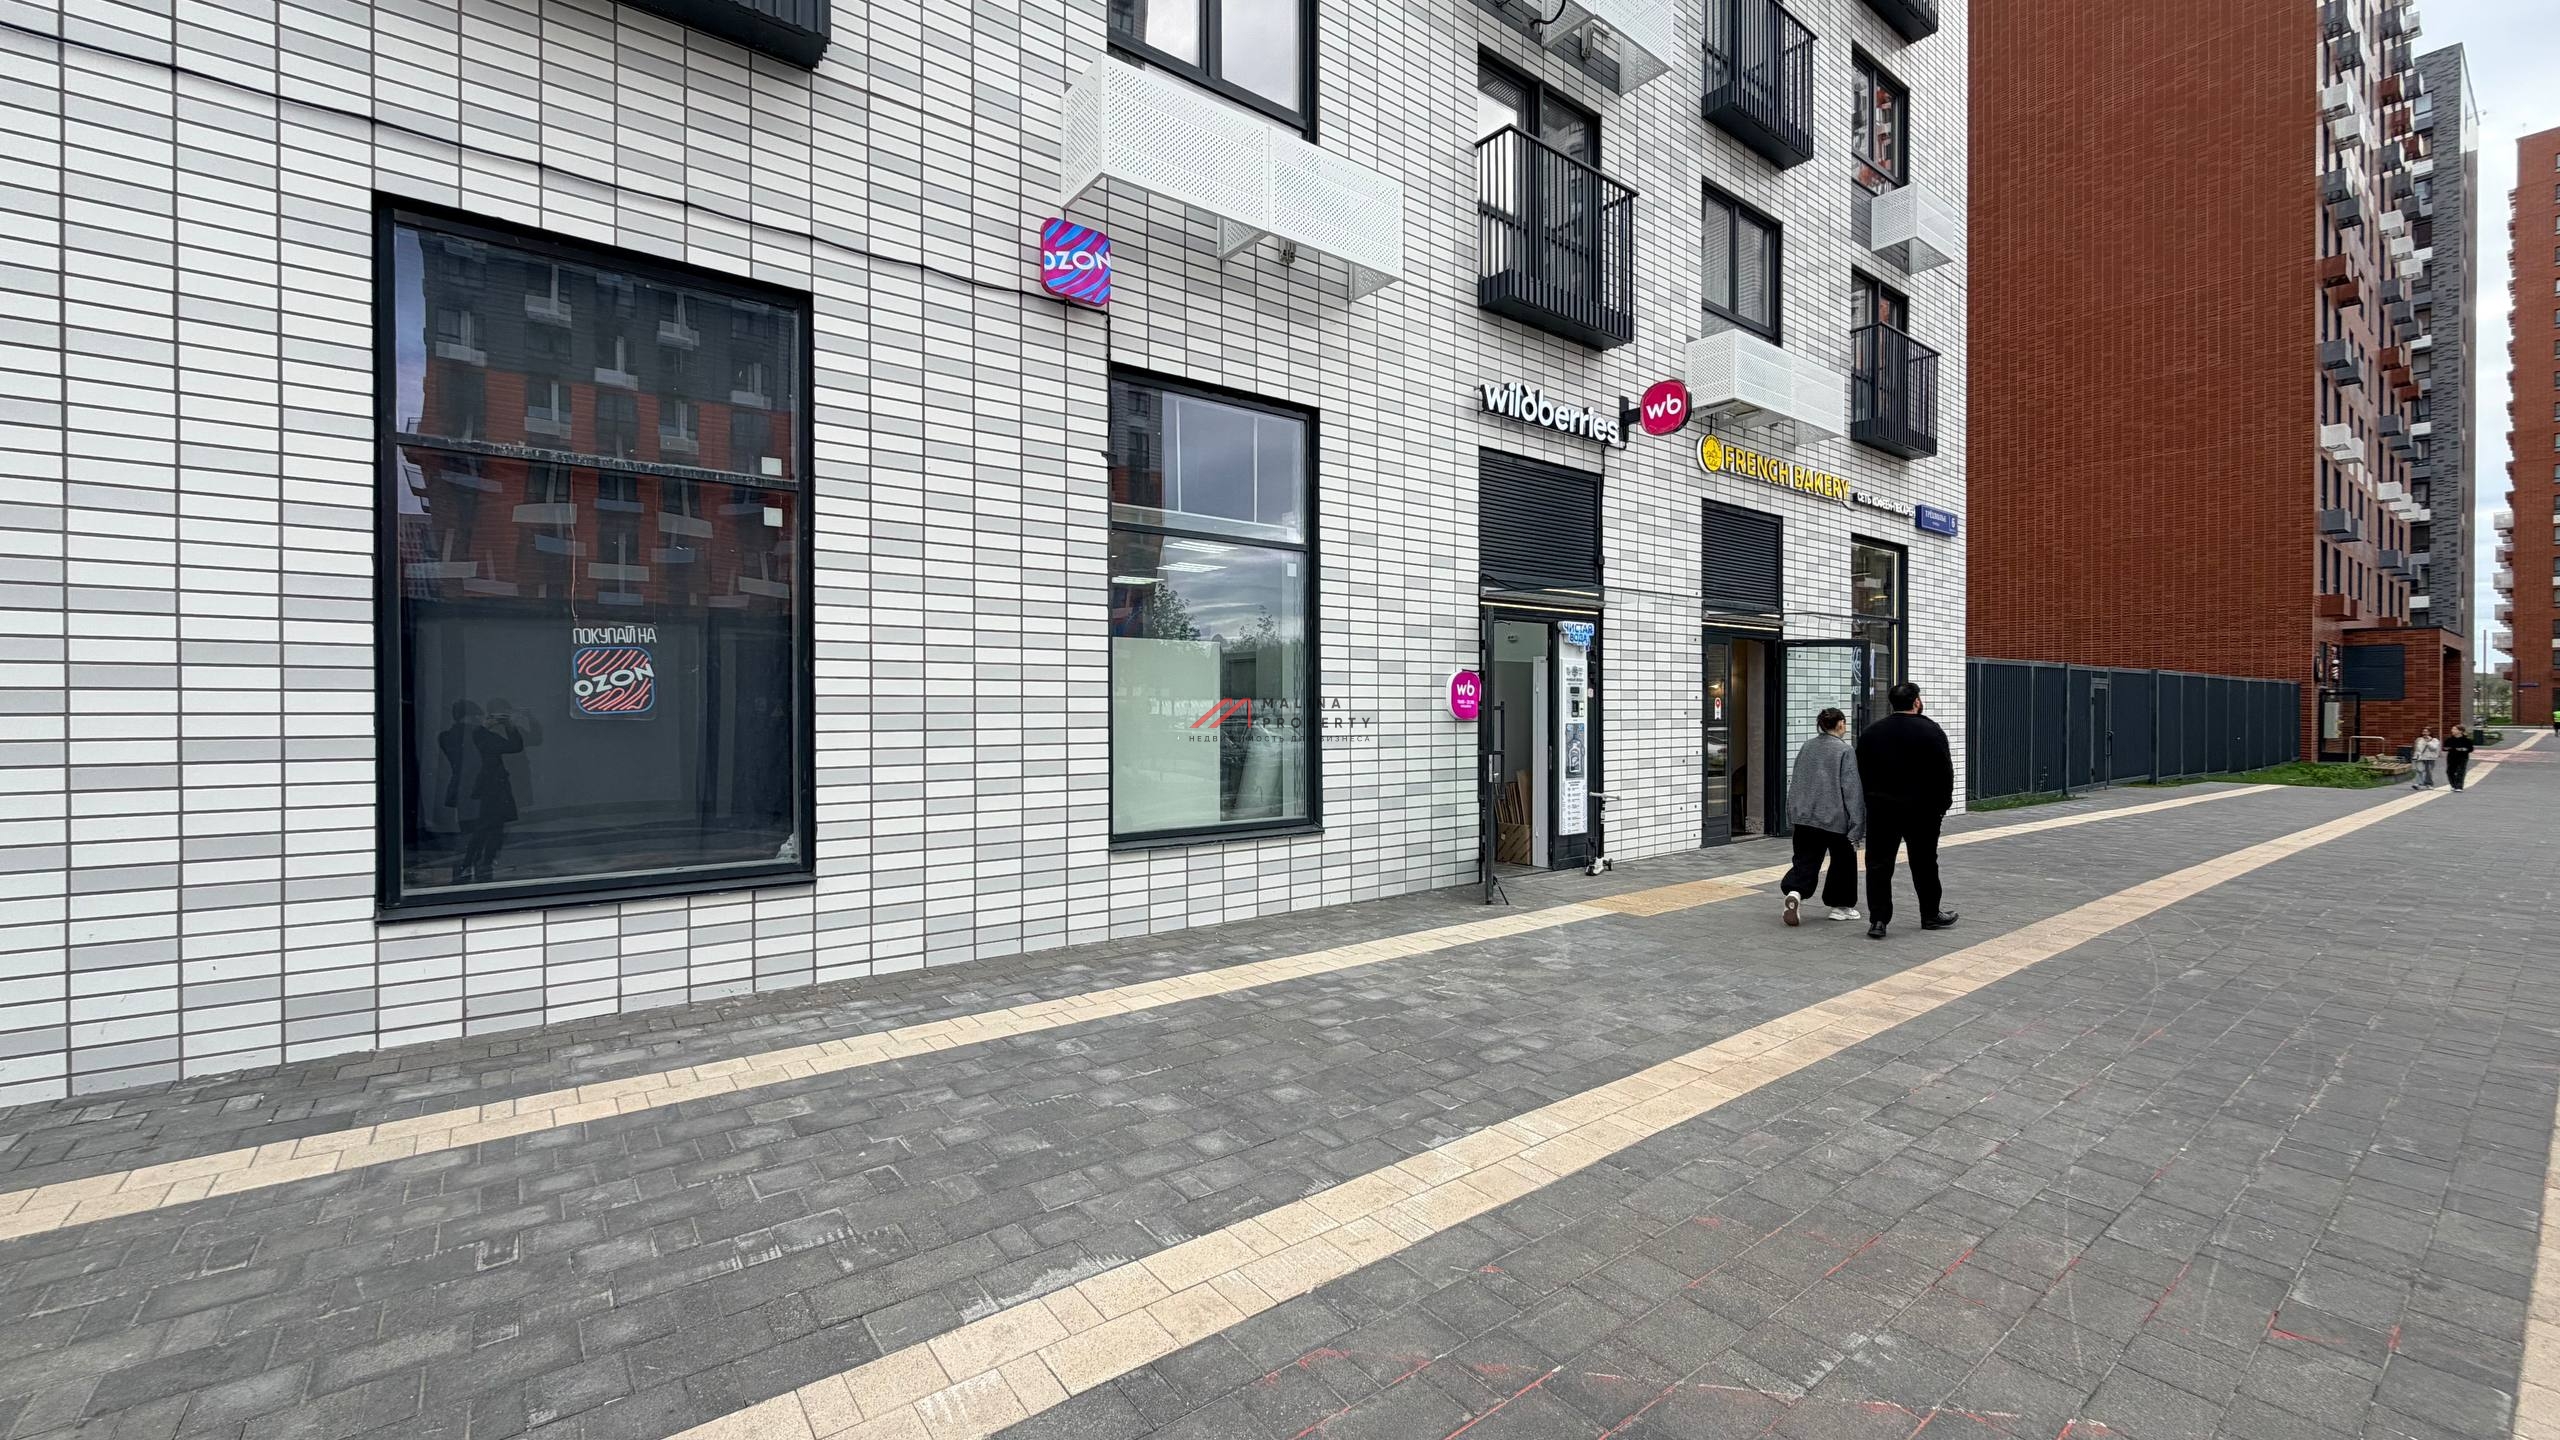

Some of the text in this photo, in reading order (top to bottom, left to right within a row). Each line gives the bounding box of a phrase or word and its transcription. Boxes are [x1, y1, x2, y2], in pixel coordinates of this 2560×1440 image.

[1044, 250, 1112, 270] OZON
[1484, 382, 1620, 444] wildberries
[1645, 393, 1682, 420] wb
[1724, 445, 1850, 500] FRENCH BAKERY
[573, 626, 657, 644] ПОКУПАЙ НА
[1563, 622, 1593, 634] ЧИСТАЯ
[1569, 633, 1588, 644] ВОДА
[573, 663, 655, 697] OZON
[1456, 680, 1475, 696] wb
